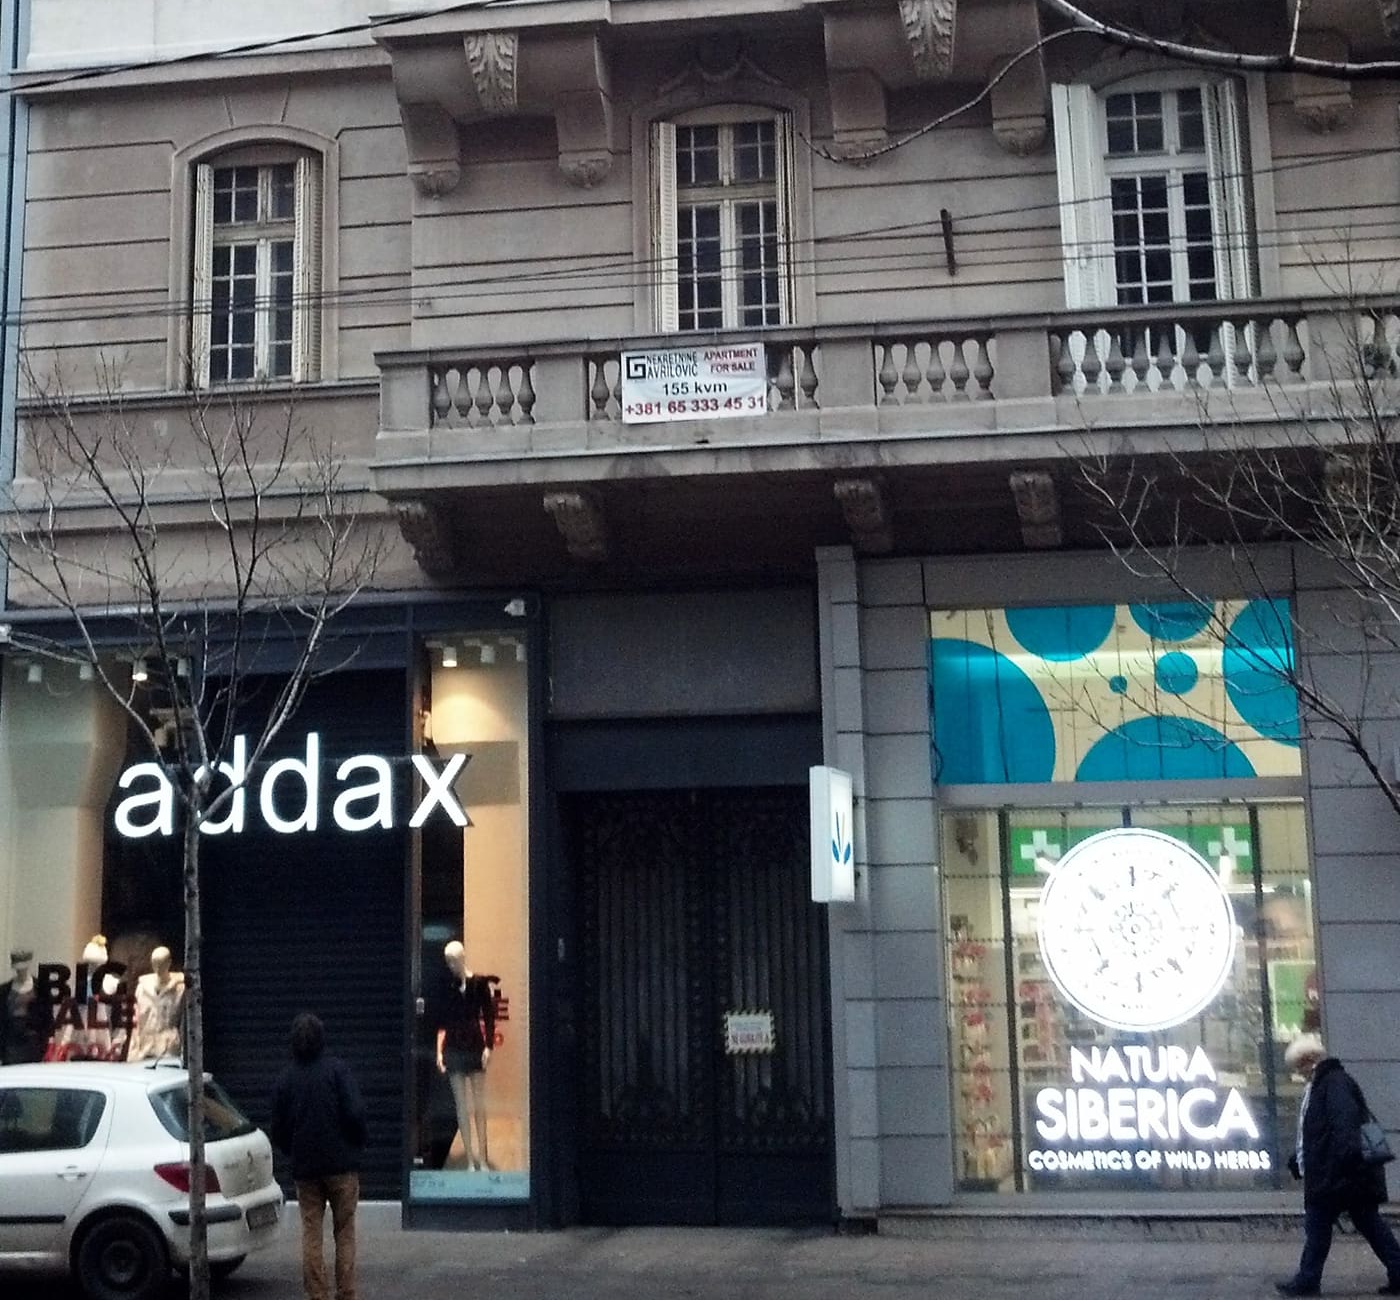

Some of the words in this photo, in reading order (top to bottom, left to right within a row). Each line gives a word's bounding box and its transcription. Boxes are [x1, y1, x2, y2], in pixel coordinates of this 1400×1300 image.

[646, 351, 697, 364] NEKRETNINE
[703, 348, 757, 360] APARTMENT
[710, 363, 730, 373] FOR
[731, 361, 755, 371] SALE
[663, 382, 689, 395] 155
[694, 381, 728, 394] kvm
[625, 402, 661, 415] +381
[667, 400, 686, 414] 65
[691, 398, 719, 412] 333
[724, 397, 743, 409] 45
[747, 396, 764, 408] 31
[114, 732, 469, 838] addax
[38, 963, 127, 1004] BIG
[1071, 1045, 1217, 1083] NATURA
[1036, 1087, 1260, 1140] SIBERICA
[1028, 1150, 1133, 1170] COSMETICS
[1135, 1151, 1162, 1170] OF
[1164, 1151, 1211, 1170] WILD
[1214, 1150, 1271, 1170] HERBS
